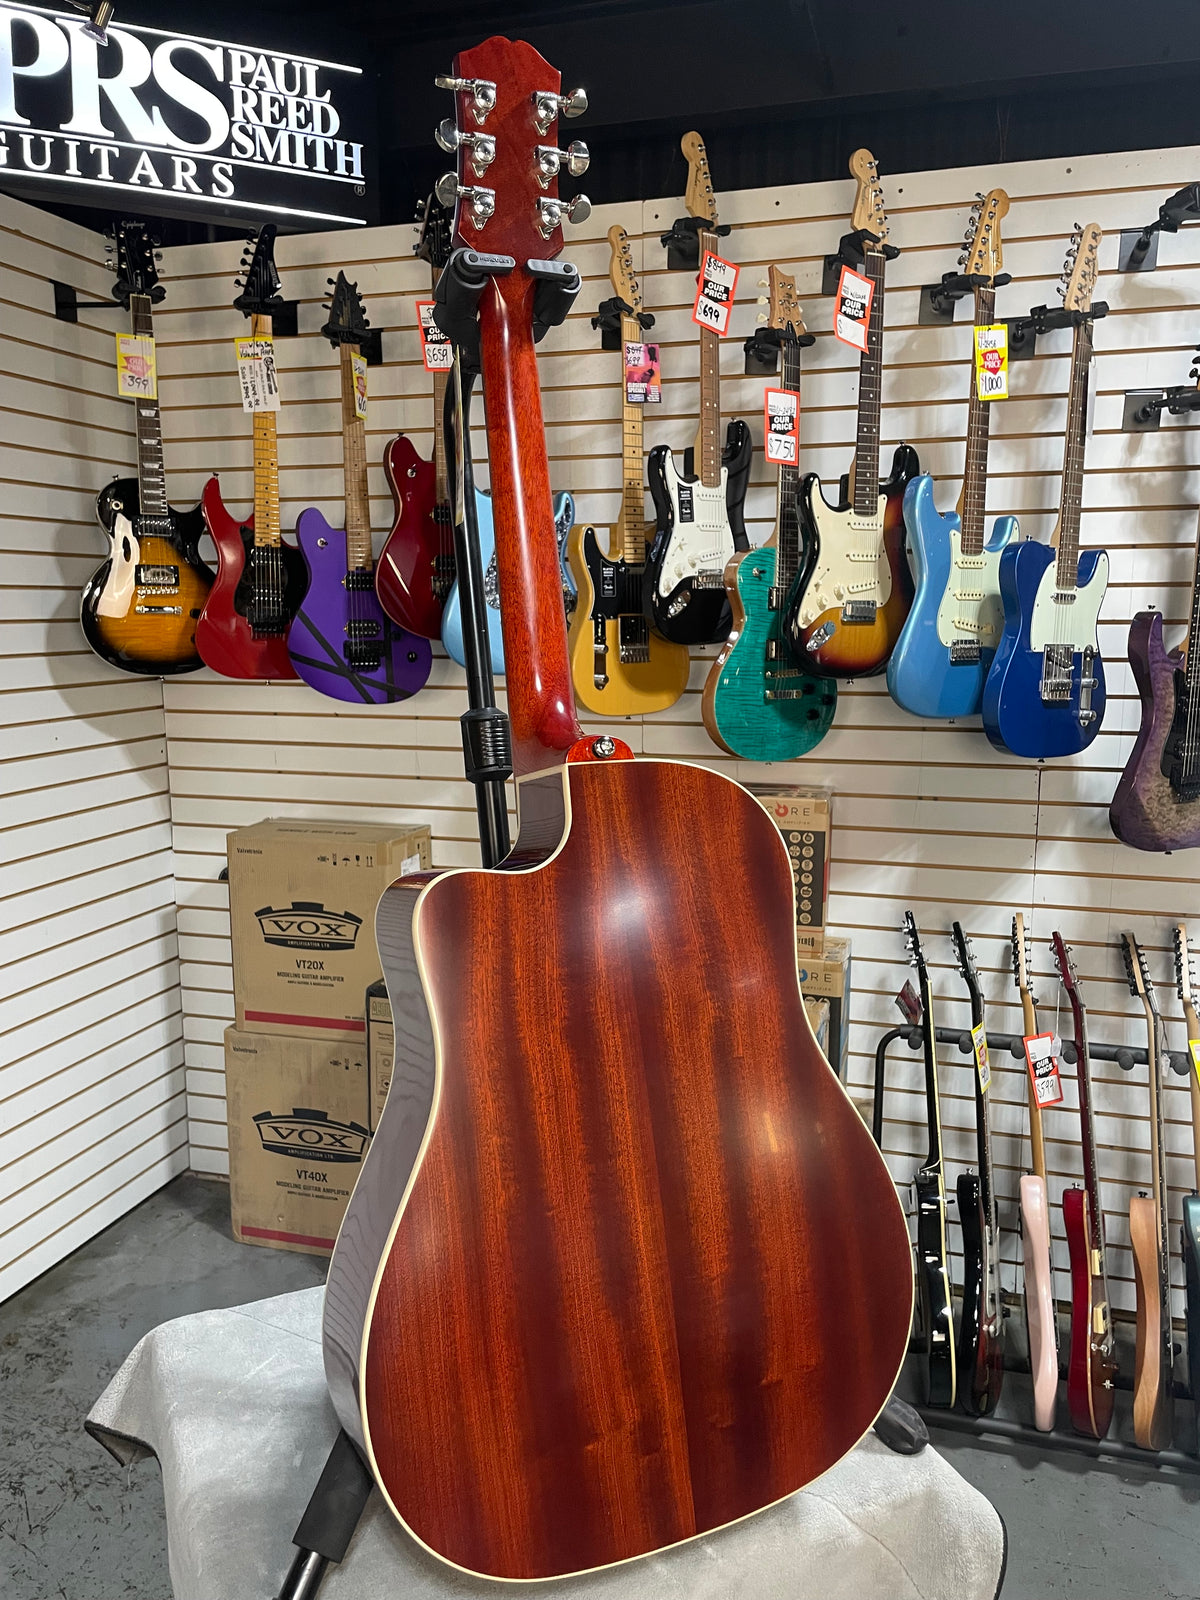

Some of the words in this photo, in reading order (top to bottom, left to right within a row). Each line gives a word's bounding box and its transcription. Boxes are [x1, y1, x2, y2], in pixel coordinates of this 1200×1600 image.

[0, 7, 230, 153] PRS
[228, 48, 332, 103] PAUL
[230, 84, 341, 138] REED
[231, 121, 365, 178] SMITH
[707, 281, 725, 293] OUR
[704, 287, 728, 301] PRICE
[844, 298, 862, 309] OUR
[698, 300, 720, 323] $699
[841, 306, 865, 318] PRICE
[428, 327, 441, 335] OU
[985, 352, 999, 361] OUR
[984, 360, 1002, 369] PRICE
[771, 422, 793, 431] PRICE
[773, 416, 790, 424] OUR
[768, 437, 795, 459] $750
[268, 919, 347, 937] VOX
[287, 940, 320, 948] AMPLIFICATION
[295, 958, 325, 971] VT20X
[276, 971, 301, 979] MODELING
[319, 975, 345, 983] AMPLIFIER
[799, 968, 832, 983] ORE
[1036, 1057, 1050, 1069] OUR
[1035, 1063, 1054, 1077] PRICE
[267, 1125, 353, 1149] VOX
[287, 1148, 323, 1158] AMPLIFICATION
[296, 1168, 328, 1183] VT40X
[275, 1180, 302, 1190] MODELING
[302, 1184, 322, 1192] GUITAR
[322, 1187, 350, 1196] AMPLIFIER
